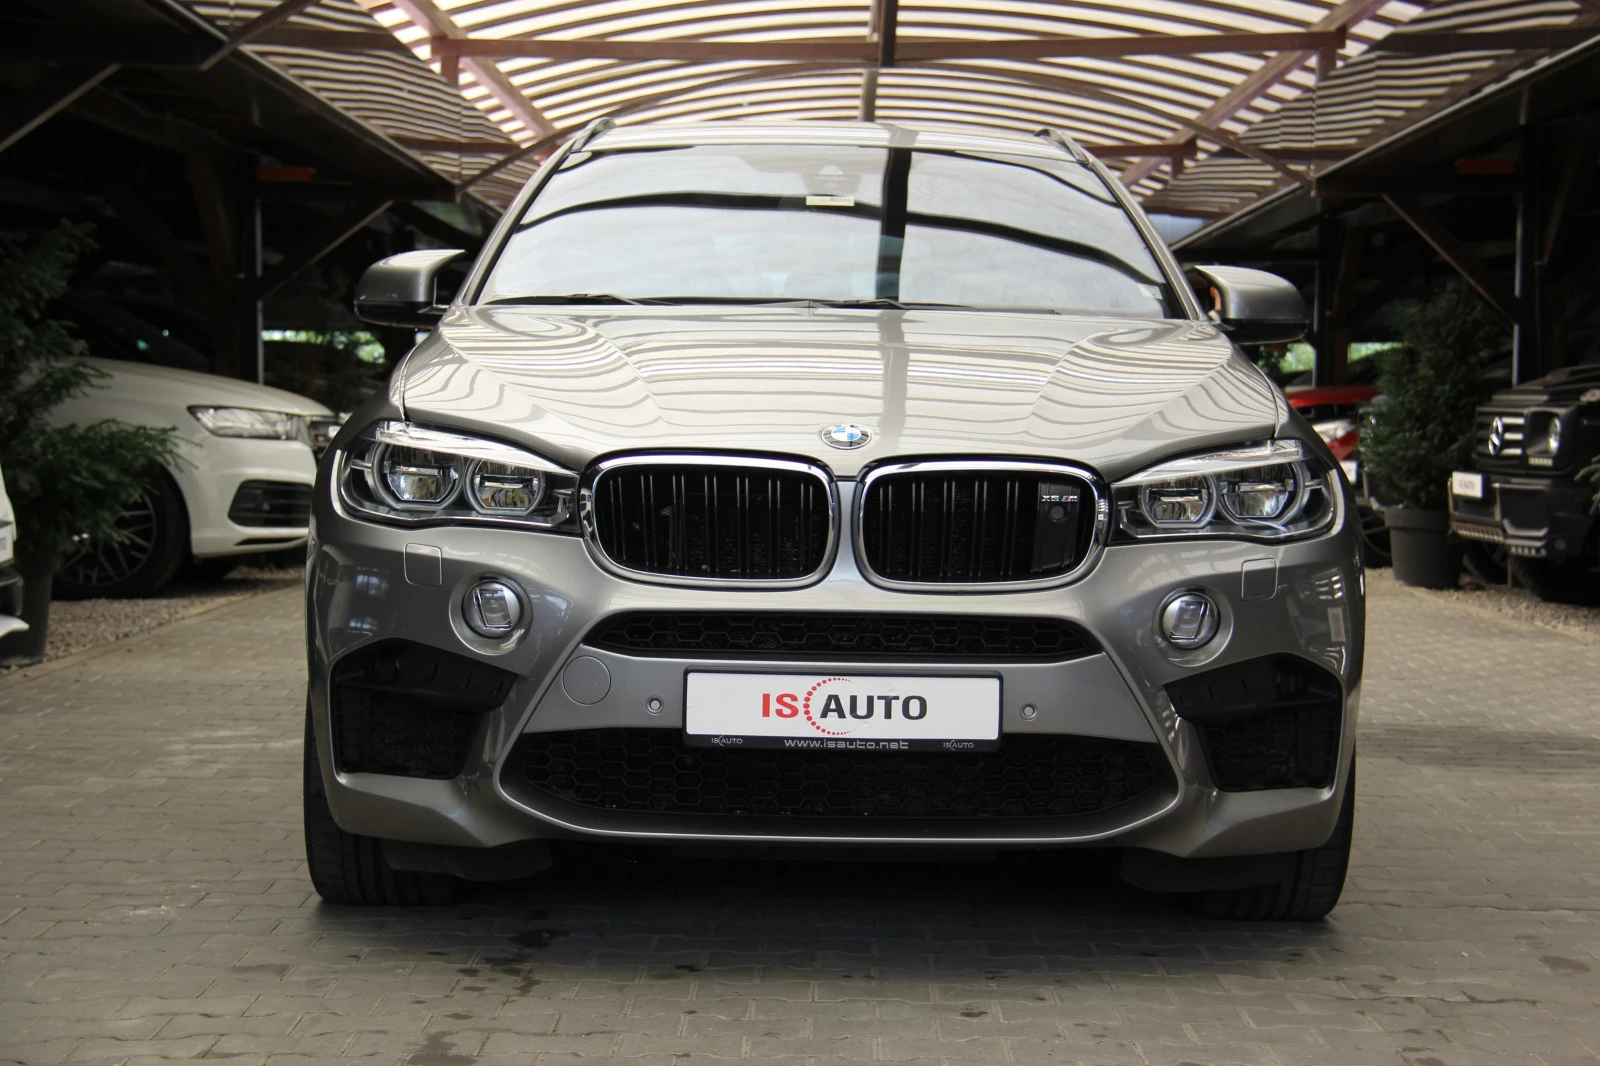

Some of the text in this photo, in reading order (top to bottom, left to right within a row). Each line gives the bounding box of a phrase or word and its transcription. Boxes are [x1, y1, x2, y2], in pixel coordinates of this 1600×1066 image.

[761, 693, 928, 721] IS AUTO
[783, 738, 909, 750] www.isauto.net
